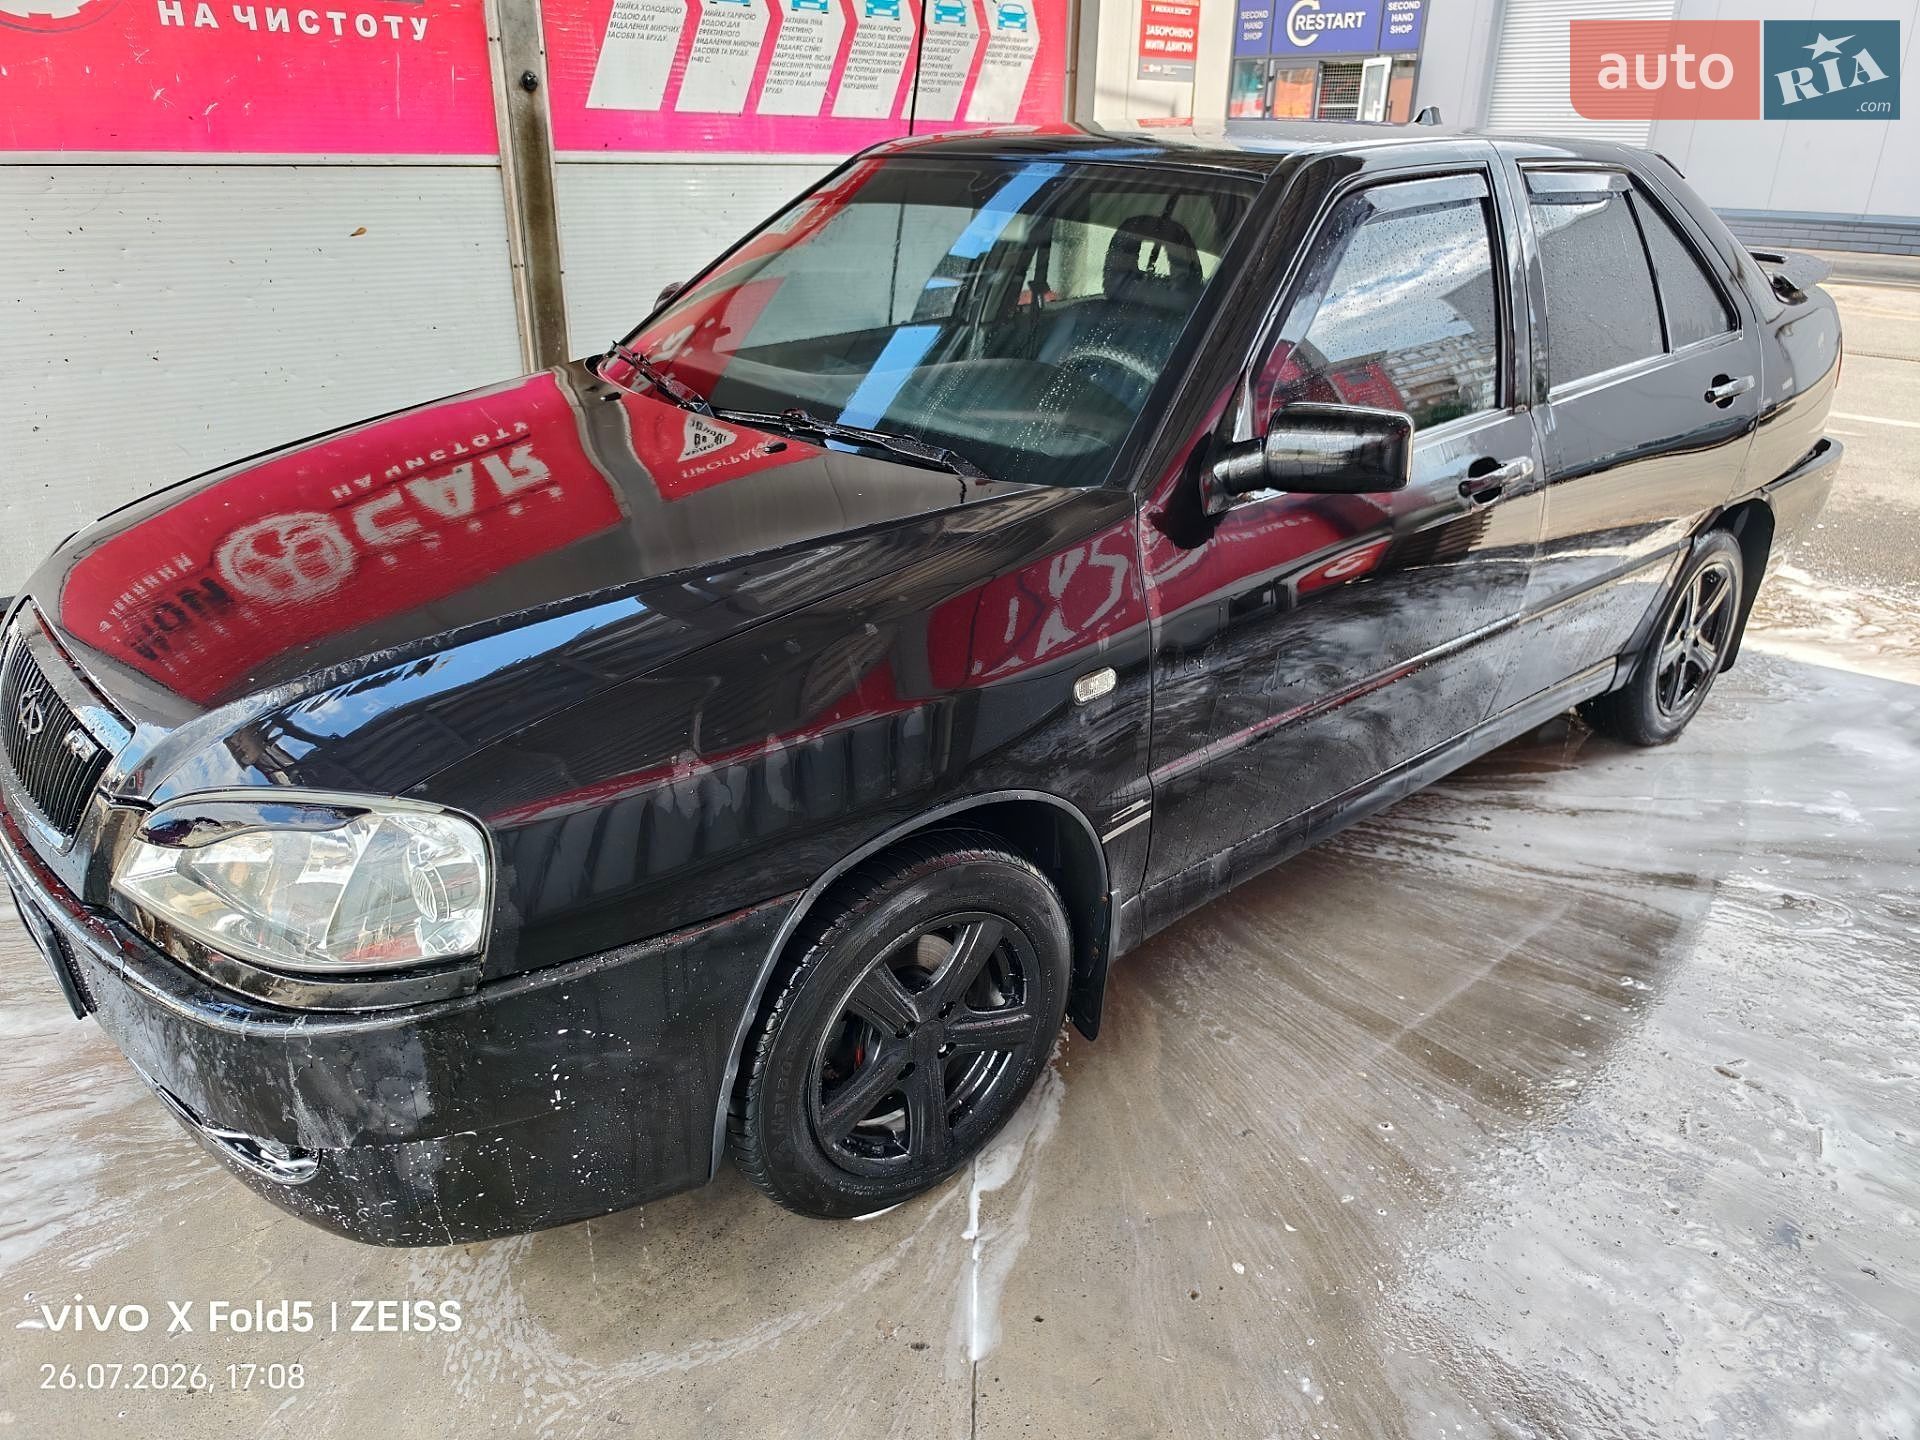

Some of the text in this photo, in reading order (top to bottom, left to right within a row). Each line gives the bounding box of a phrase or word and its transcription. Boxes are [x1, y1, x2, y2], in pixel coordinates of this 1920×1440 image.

[640, 4, 682, 14] ХОЛОДНОЮ
[1388, 0, 1421, 12] SECOND
[612, 12, 656, 22] ВОДОЮ ДЛЯ
[1240, 10, 1268, 20] SECOND
[1392, 12, 1414, 22] HAND
[157, 0, 429, 41] НА ЧИСТОТУ
[702, 19, 726, 28] ВОДОЮ
[1244, 21, 1264, 30] HAND
[1296, 11, 1366, 31] RESTART
[610, 21, 649, 31] ВИДАЛЕННЯ
[1146, 24, 1194, 38] ЗАБОРОНЕНО
[1390, 22, 1413, 34] SHOP
[608, 30, 636, 40] ЗАСОБІВ
[1243, 30, 1263, 41] SHOP
